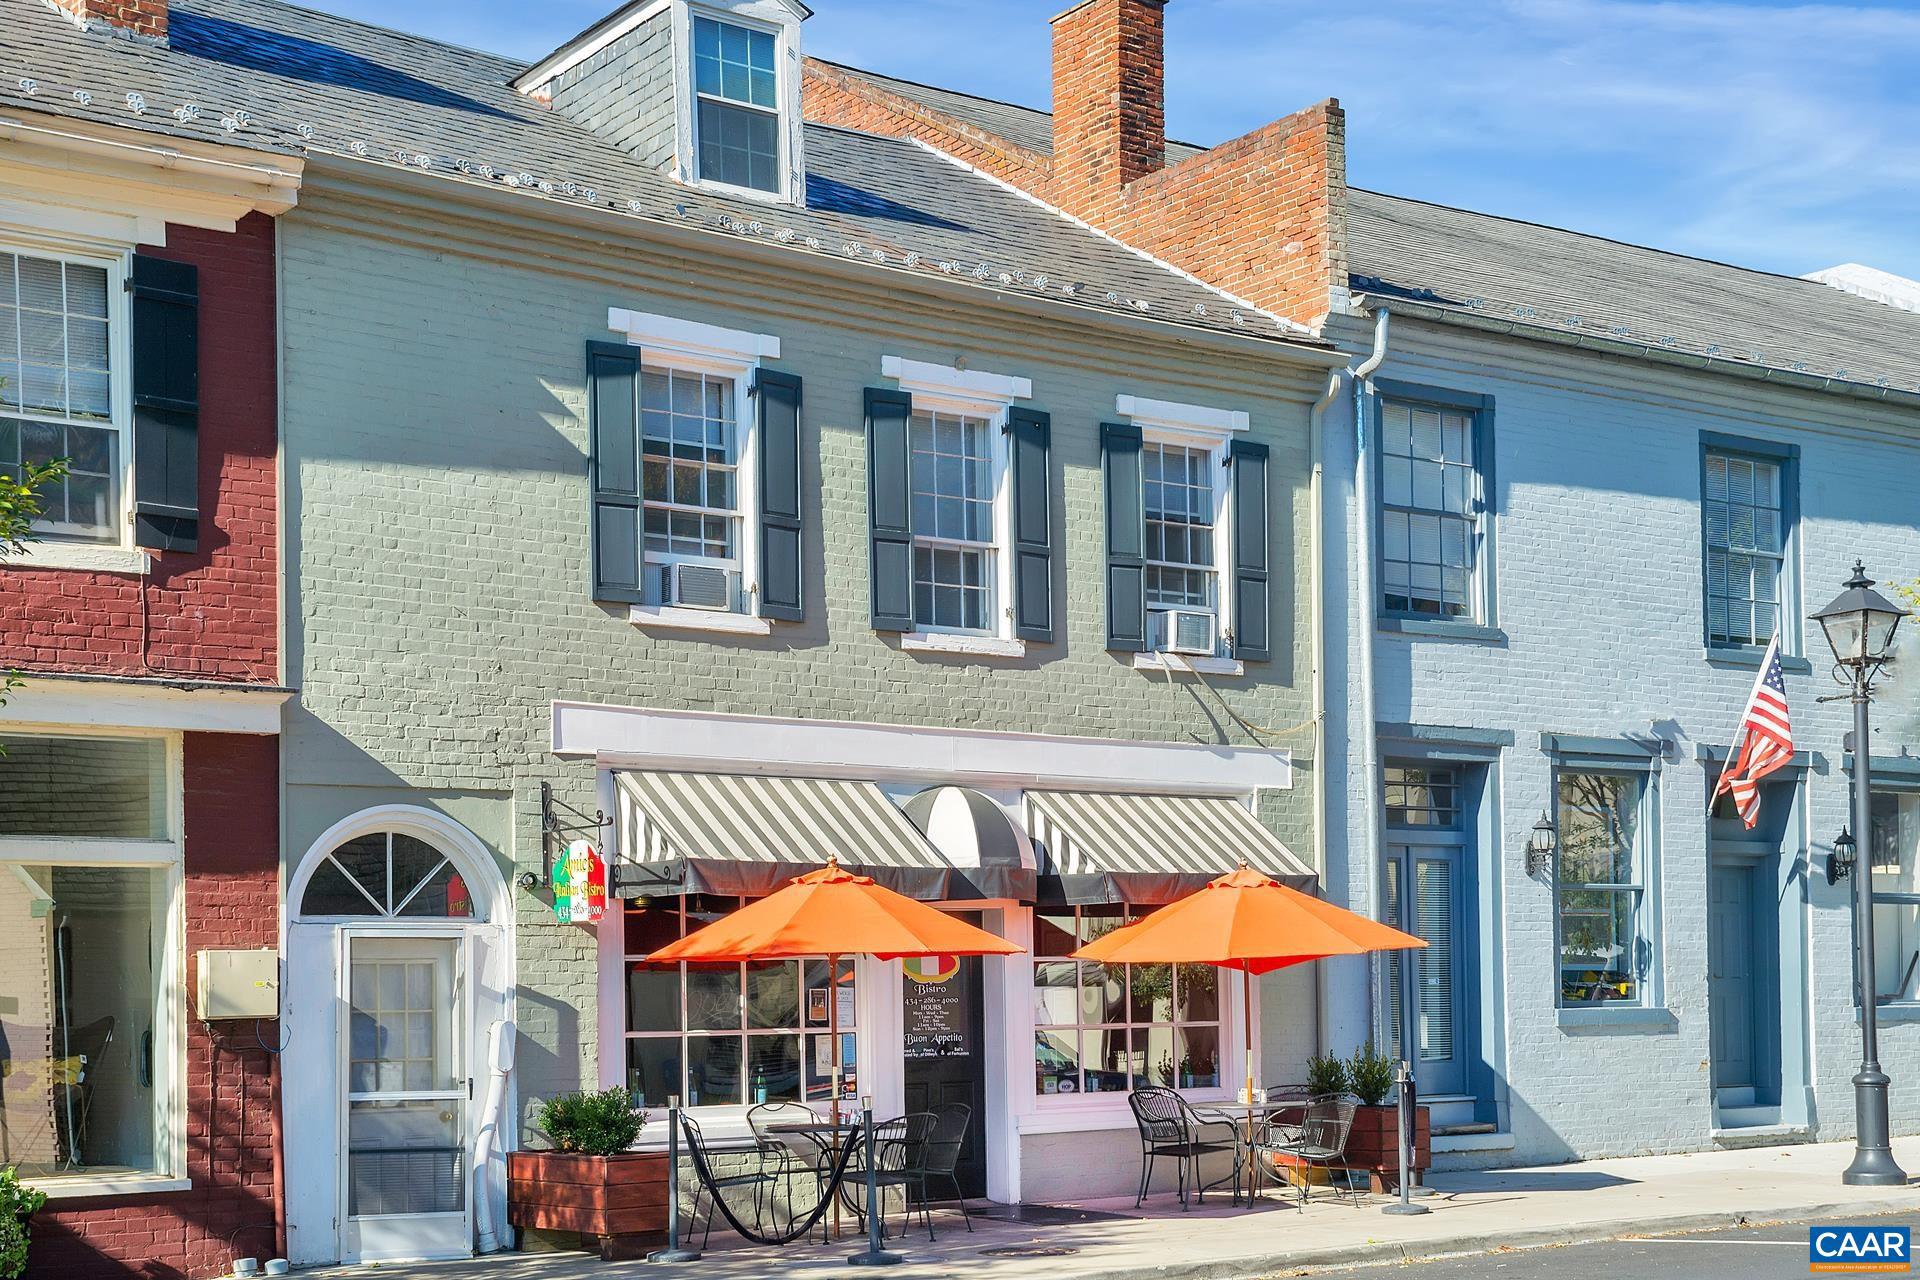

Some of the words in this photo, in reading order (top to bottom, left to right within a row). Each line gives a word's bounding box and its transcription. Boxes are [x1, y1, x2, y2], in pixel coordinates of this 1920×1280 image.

[580, 880, 604, 900] Bistro
[914, 984, 946, 995] Bistro
[904, 1034, 928, 1045] Buon
[931, 1033, 963, 1045] Appetito
